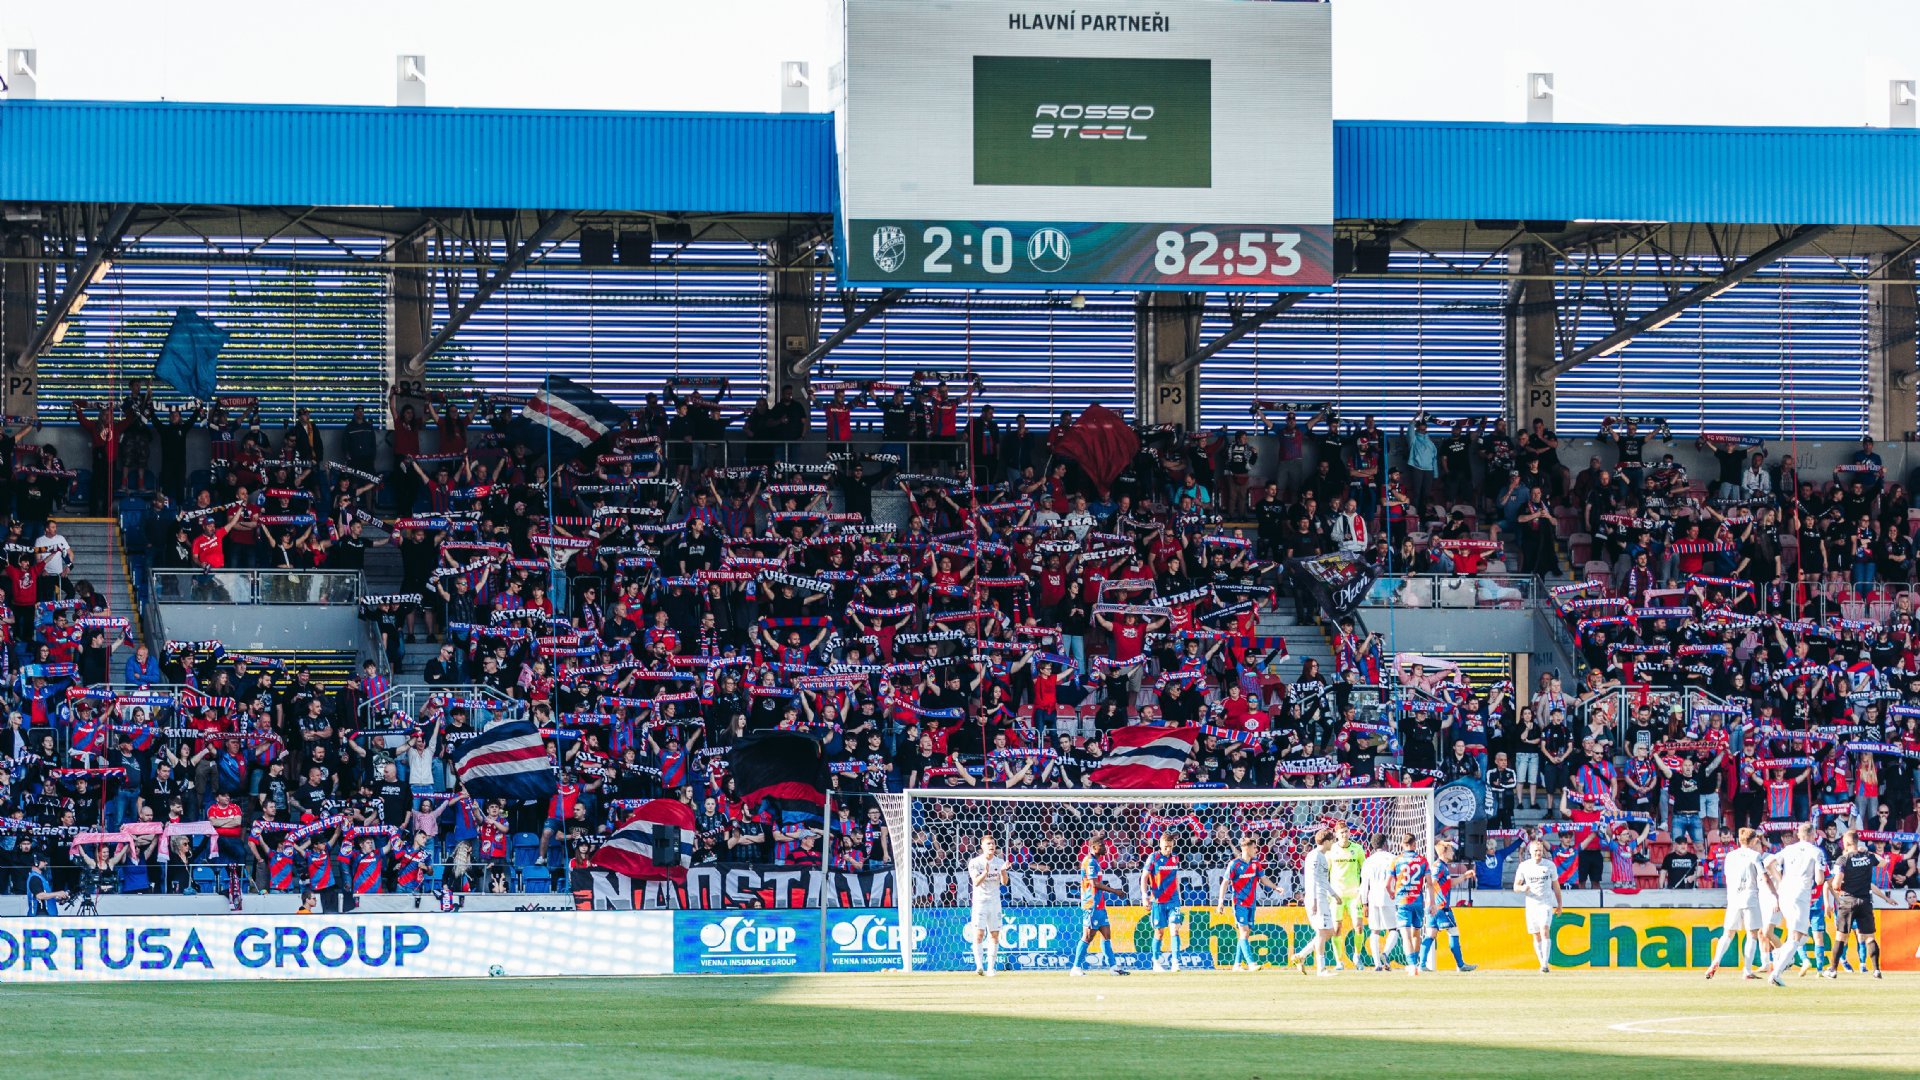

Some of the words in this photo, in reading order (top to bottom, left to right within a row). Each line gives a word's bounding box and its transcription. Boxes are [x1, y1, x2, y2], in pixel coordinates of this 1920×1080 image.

[1008, 11, 1075, 31] HLAVNÍ
[1080, 13, 1169, 33] PARTNEŘI
[1036, 104, 1154, 120] ROSSO
[1031, 125, 1147, 140] STEEL
[1154, 231, 1302, 277] 82:53
[10, 377, 32, 395] P2
[1160, 387, 1182, 404] P3
[1531, 390, 1552, 407] P3
[775, 461, 838, 474] VIKTORIA
[771, 485, 779, 493] FC
[539, 537, 569, 546] VIKTORIA
[700, 570, 708, 579] FC
[708, 571, 740, 580] VIKTORIA
[765, 570, 832, 592] VIKTORIA
[1565, 582, 1588, 591] VIKTORIA
[363, 592, 421, 605] VIKTORIA
[1153, 585, 1208, 607] ULTRAS
[865, 607, 892, 616] VIKTORIA
[1635, 606, 1694, 618] VIKTORIA
[86, 618, 110, 626] VIKTORIA
[897, 631, 963, 645] VIKTORIA
[1685, 645, 1711, 653] VIKTORIA
[1000, 749, 1009, 758] FC
[1847, 743, 1880, 751] VIKTORIA
[294, 821, 323, 839] VIKTORIA
[1863, 832, 1893, 840] VIKTORIA
[1399, 864, 1421, 888] 32
[736, 918, 797, 952] ČPP
[1133, 910, 1410, 968] Chanc
[1547, 911, 1832, 968] Chane
[234, 925, 430, 968] GROUP
[700, 958, 728, 967] VIENNA
[729, 958, 771, 967] INSURANCE
[771, 957, 797, 967] GROUP
[832, 957, 860, 966] VIENNA
[860, 956, 902, 966] INSURANCE
